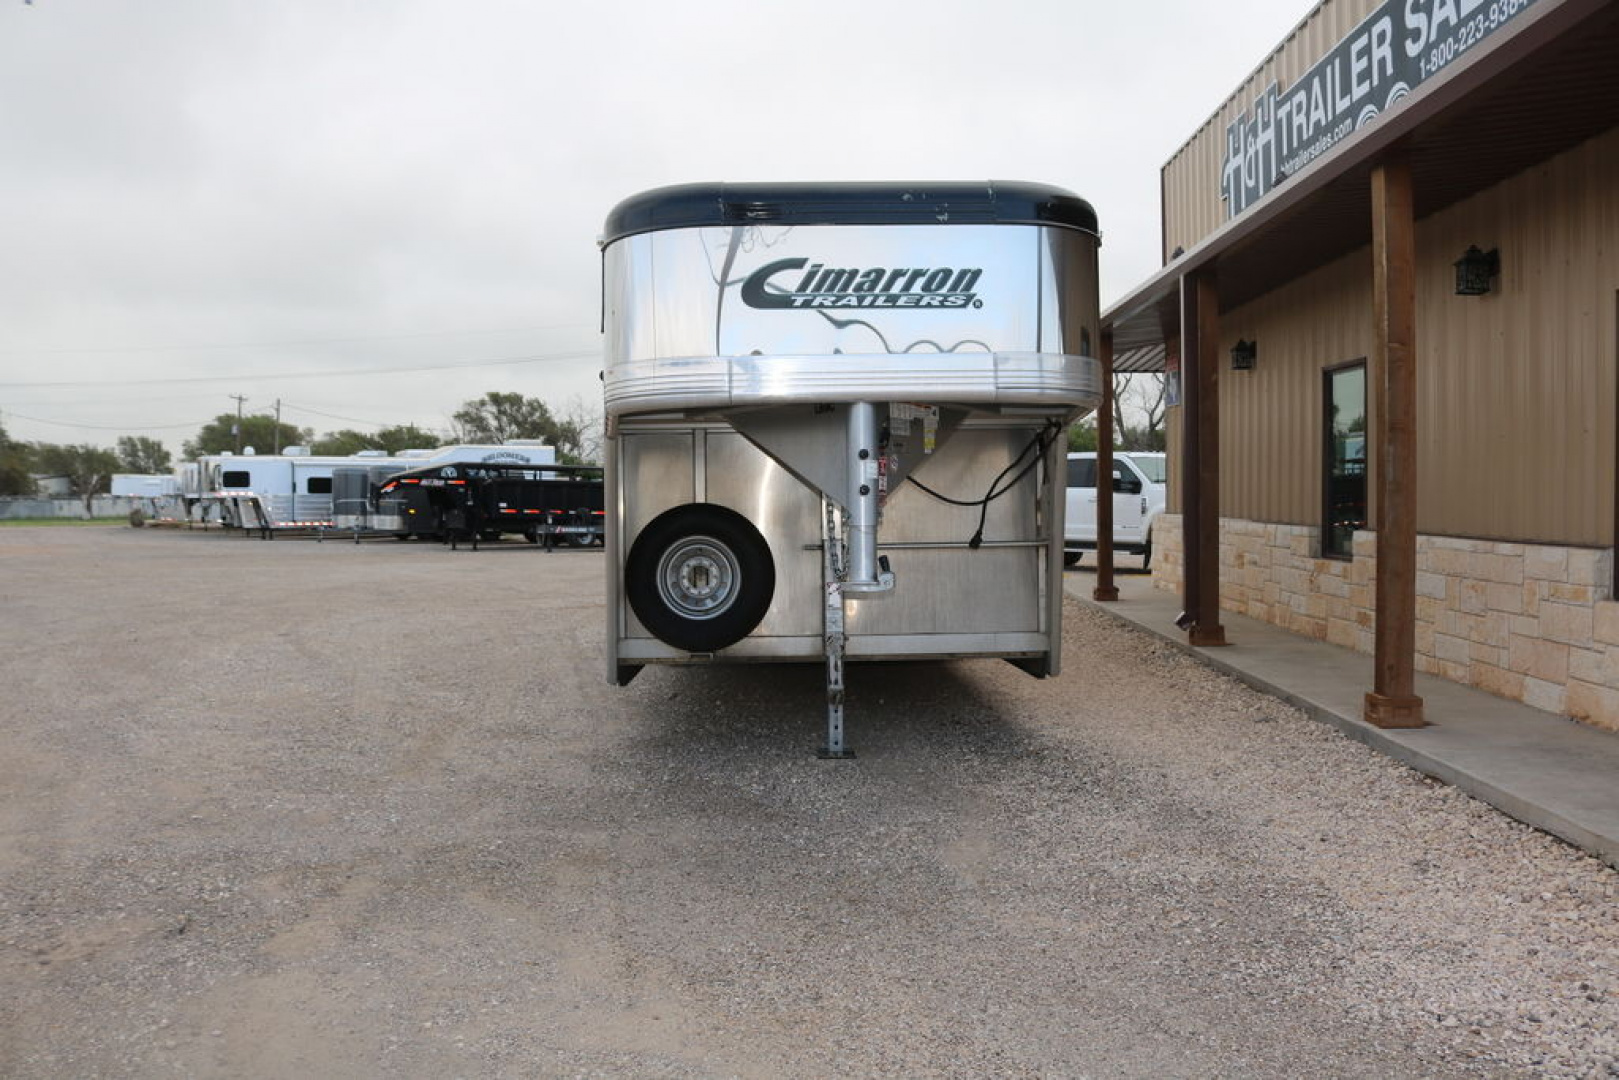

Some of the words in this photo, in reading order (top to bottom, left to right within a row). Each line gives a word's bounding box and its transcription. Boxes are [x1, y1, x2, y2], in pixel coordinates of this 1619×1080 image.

[1222, 90, 1276, 218] H&H
[1278, 15, 1394, 157] TRAILER
[1404, 0, 1484, 58] SA
[741, 257, 983, 309] Cimarron
[789, 294, 968, 307] TRAILERS
